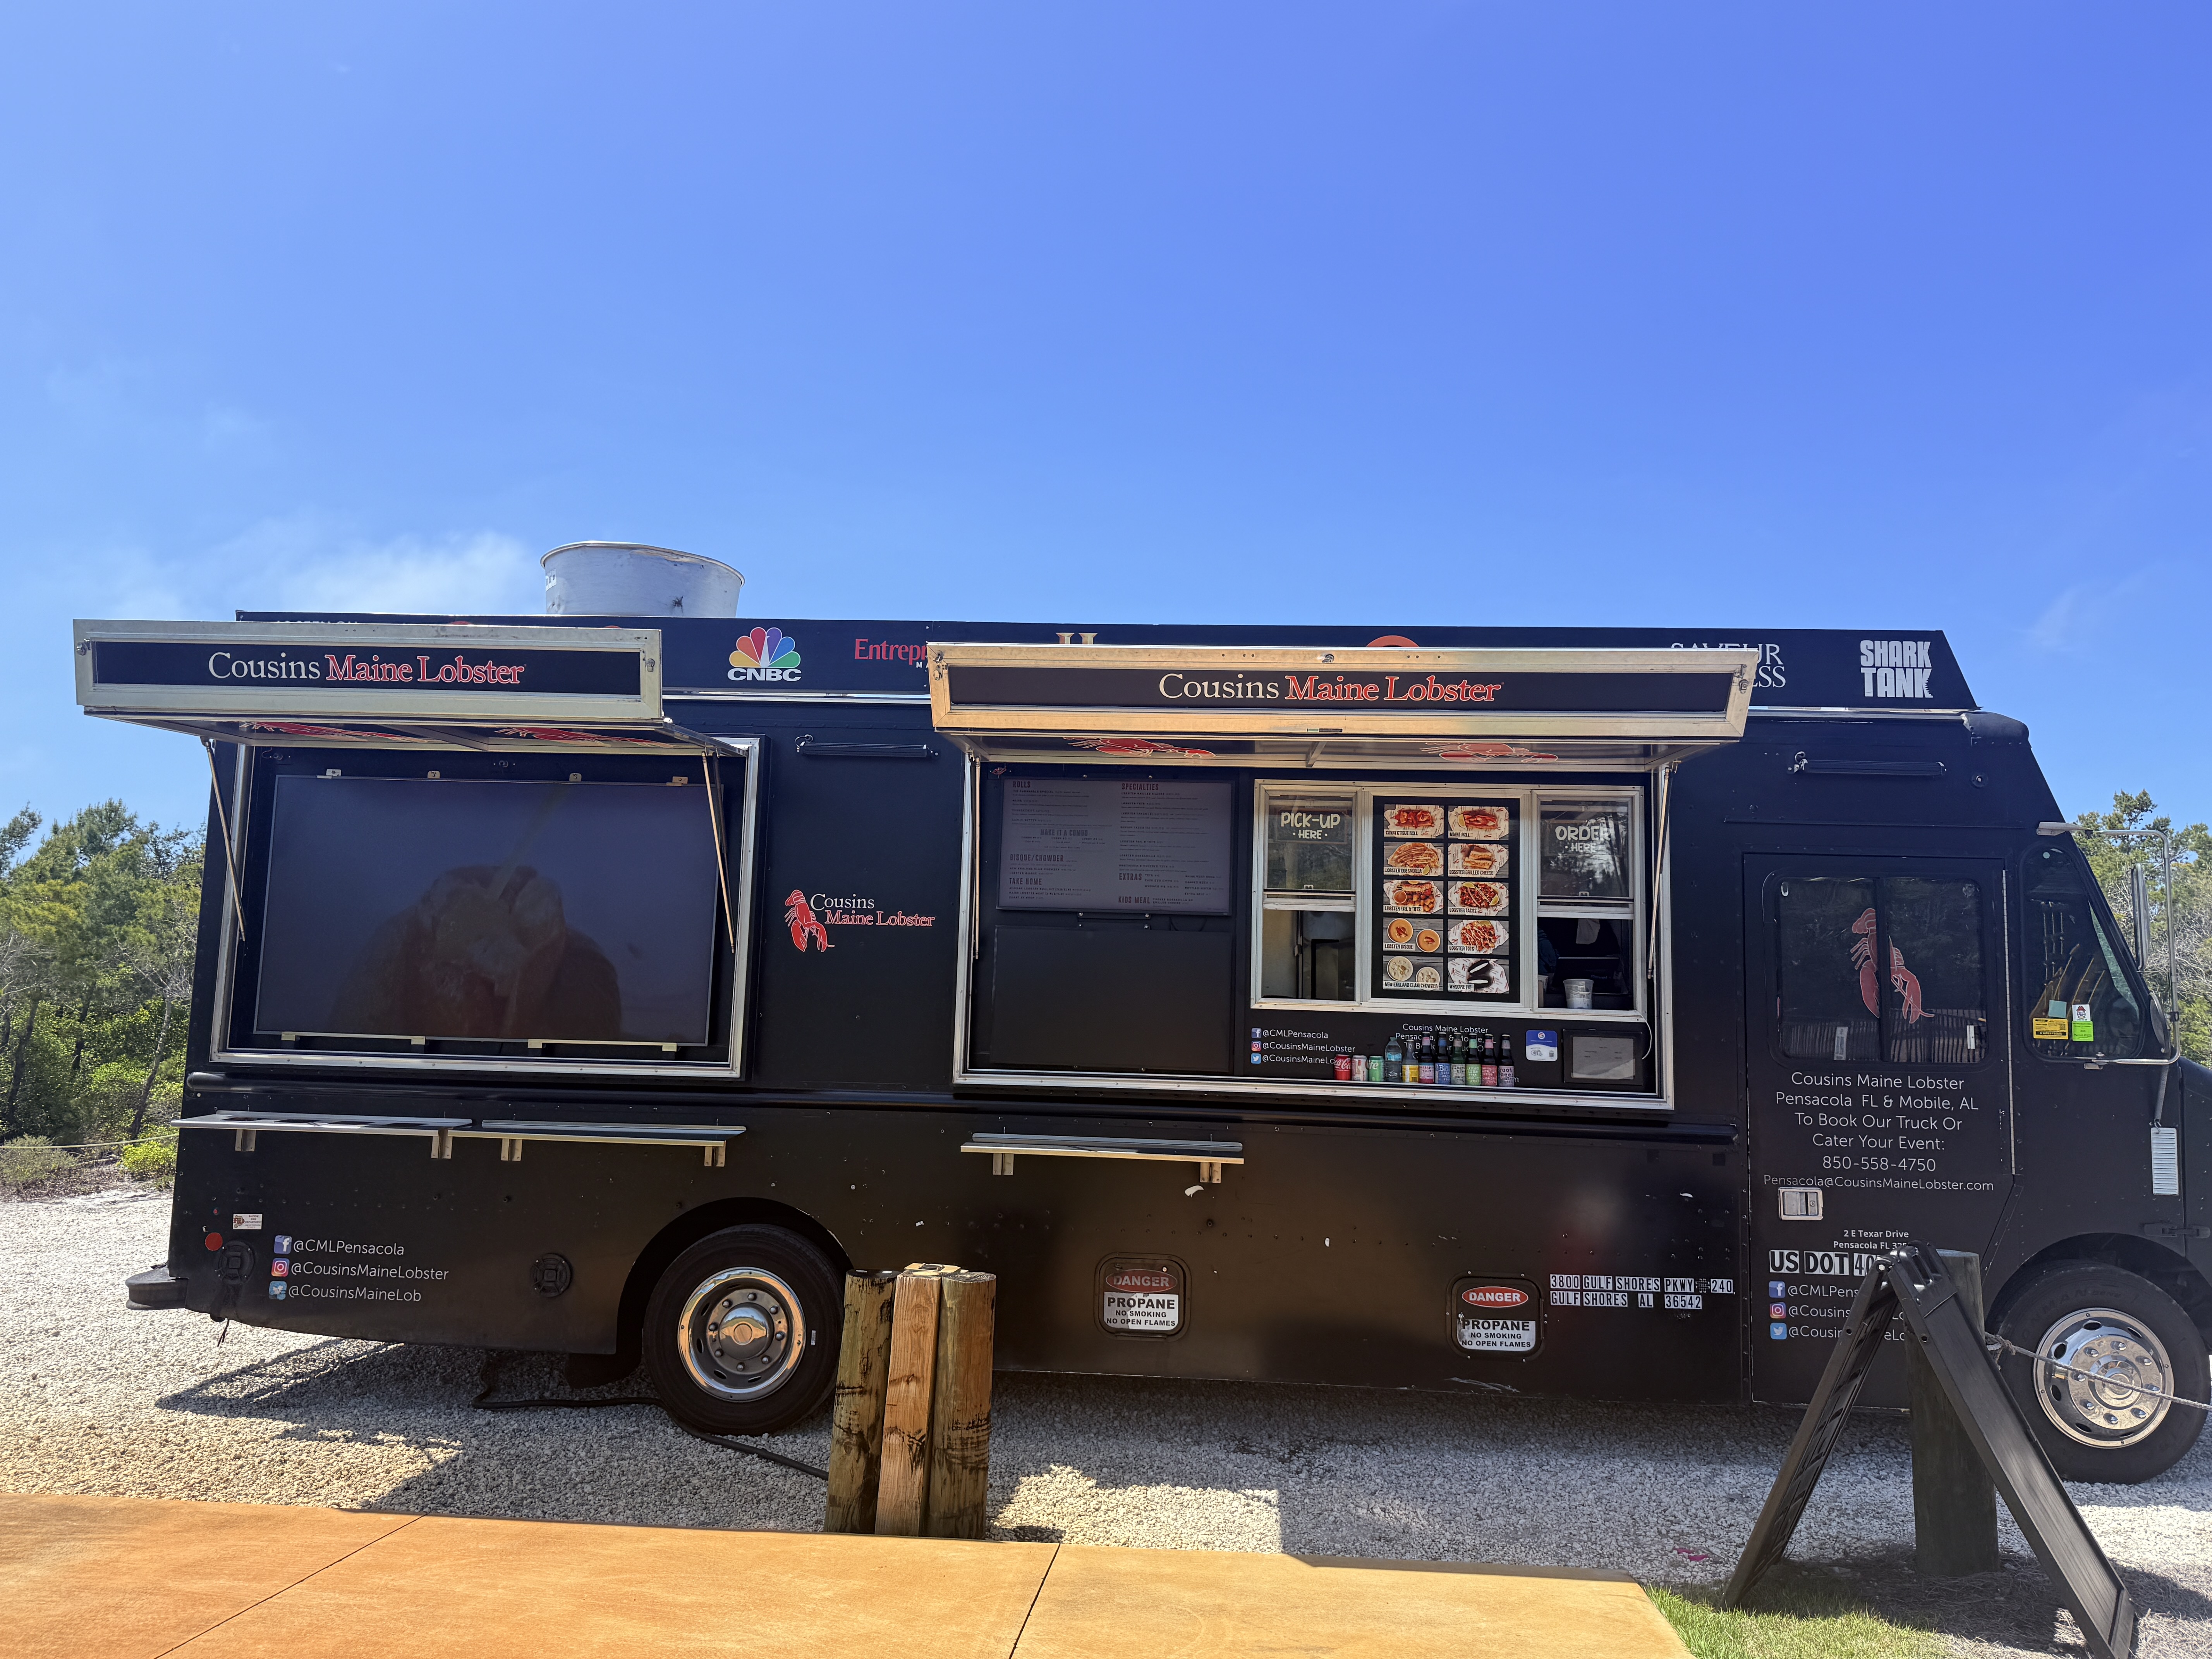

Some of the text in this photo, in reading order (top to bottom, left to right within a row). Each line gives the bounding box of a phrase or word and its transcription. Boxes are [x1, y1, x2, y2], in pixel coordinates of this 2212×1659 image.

[855, 639, 927, 665] Entrepr
[1860, 640, 1932, 668] SHARK
[209, 652, 525, 684] Cousins Maine Lobster
[727, 668, 802, 682] CNBC
[1159, 673, 1500, 702] Cousins Maine Lobster
[1861, 668, 1933, 698] TANK
[1281, 812, 1340, 828] PICK-UP
[1298, 830, 1322, 839] HERE
[1555, 826, 1611, 841] ORDER
[1571, 842, 1596, 853] HERE
[1010, 854, 1064, 862] BISQUE/CHOWDER
[1119, 873, 1142, 881] EXTRAS
[811, 894, 874, 910] Cousins
[824, 910, 935, 927] Maine Lobster
[1263, 1029, 1328, 1039] @CMLPensacola
[1396, 1032, 1435, 1041] Pensaca,
[1263, 1042, 1355, 1052] @CousinsMaineLobster
[1262, 1054, 1334, 1064] @CousinsMaineLo
[1791, 1072, 1964, 1090] Cousins Maine Lobster
[1776, 1092, 1978, 1111] Pensacola FL & Mobile, AL
[1795, 1112, 1963, 1131] To Book Our Truck Or
[1813, 1133, 1944, 1150] Cater Your Event:
[1822, 1156, 1936, 1171] 850-558-4750
[1764, 1175, 1994, 1191] Pensacola@CousinsMaineLobster.com
[294, 1239, 404, 1255] @CMLPensacola
[1834, 1241, 1877, 1249] Pensacola
[291, 1262, 448, 1280] @CousinsMaineLobster
[1770, 1251, 1875, 1275] US DOT 40
[1113, 1276, 1169, 1287] DANGER
[1551, 1275, 1579, 1288] 3800
[1584, 1276, 1611, 1289] GULF
[1617, 1277, 1659, 1290] SHORES
[1666, 1279, 1693, 1291] PKWY
[289, 1284, 421, 1302] @CousinsMaineLob
[1469, 1292, 1521, 1302] DANGER
[1788, 1285, 1859, 1297] @CMLPens
[1108, 1297, 1175, 1309] PROPANE
[1551, 1292, 1701, 1308] GULF SHORES AL 36542
[1462, 1320, 1530, 1331] PROPANE
